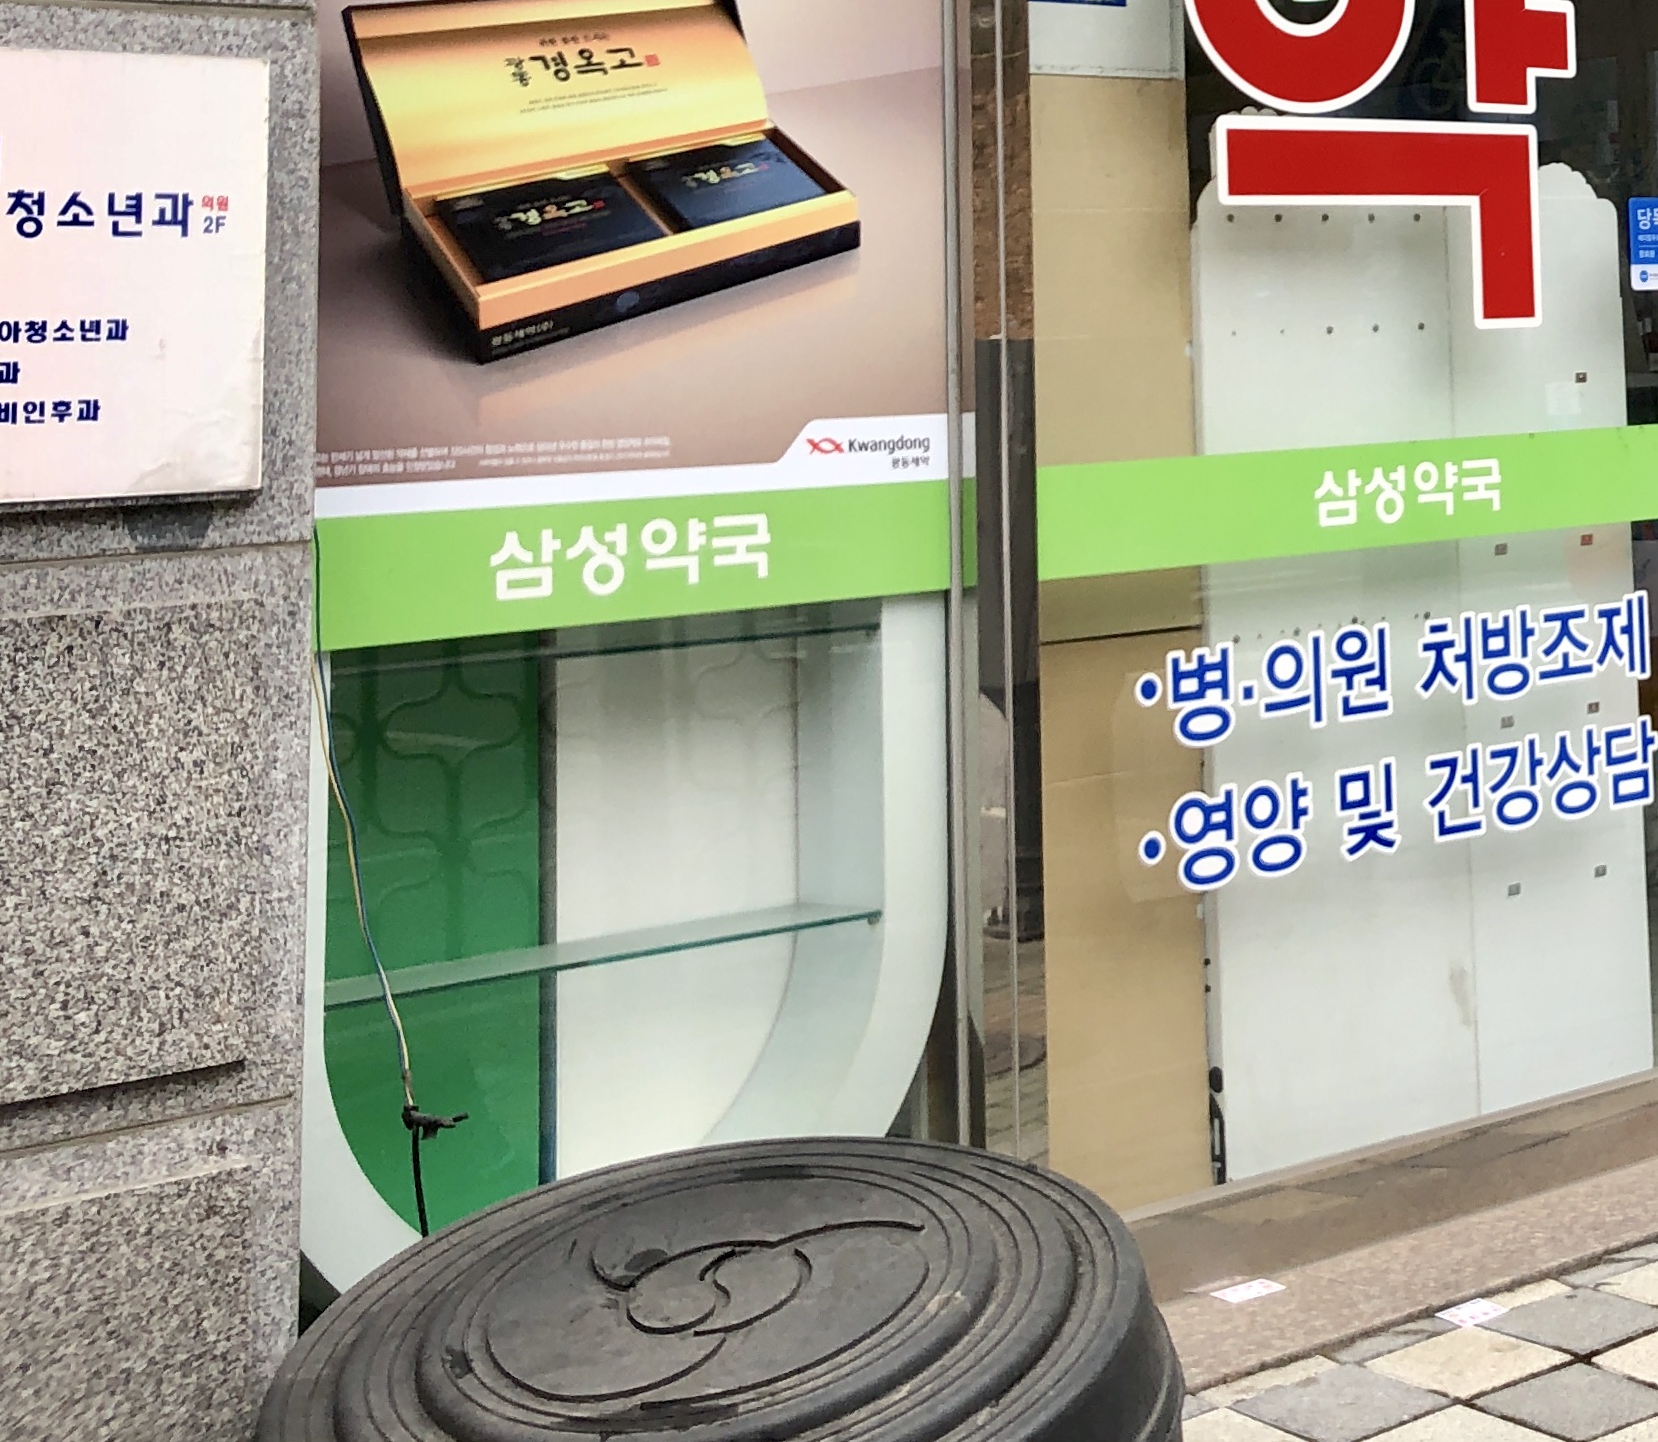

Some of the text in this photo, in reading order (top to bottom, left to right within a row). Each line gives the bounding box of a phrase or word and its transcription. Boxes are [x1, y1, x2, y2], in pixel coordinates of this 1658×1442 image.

[6, 189, 194, 239] 청소년과
[201, 195, 229, 212] 의원
[203, 215, 227, 234] 2F
[848, 434, 931, 455] Kwangdong
[1313, 458, 1504, 529] 삼성약국
[490, 513, 772, 601] 삼성약국
[1416, 590, 1652, 703] 처방조제
[1170, 773, 1312, 890] 영양
[1337, 758, 1400, 861] 및
